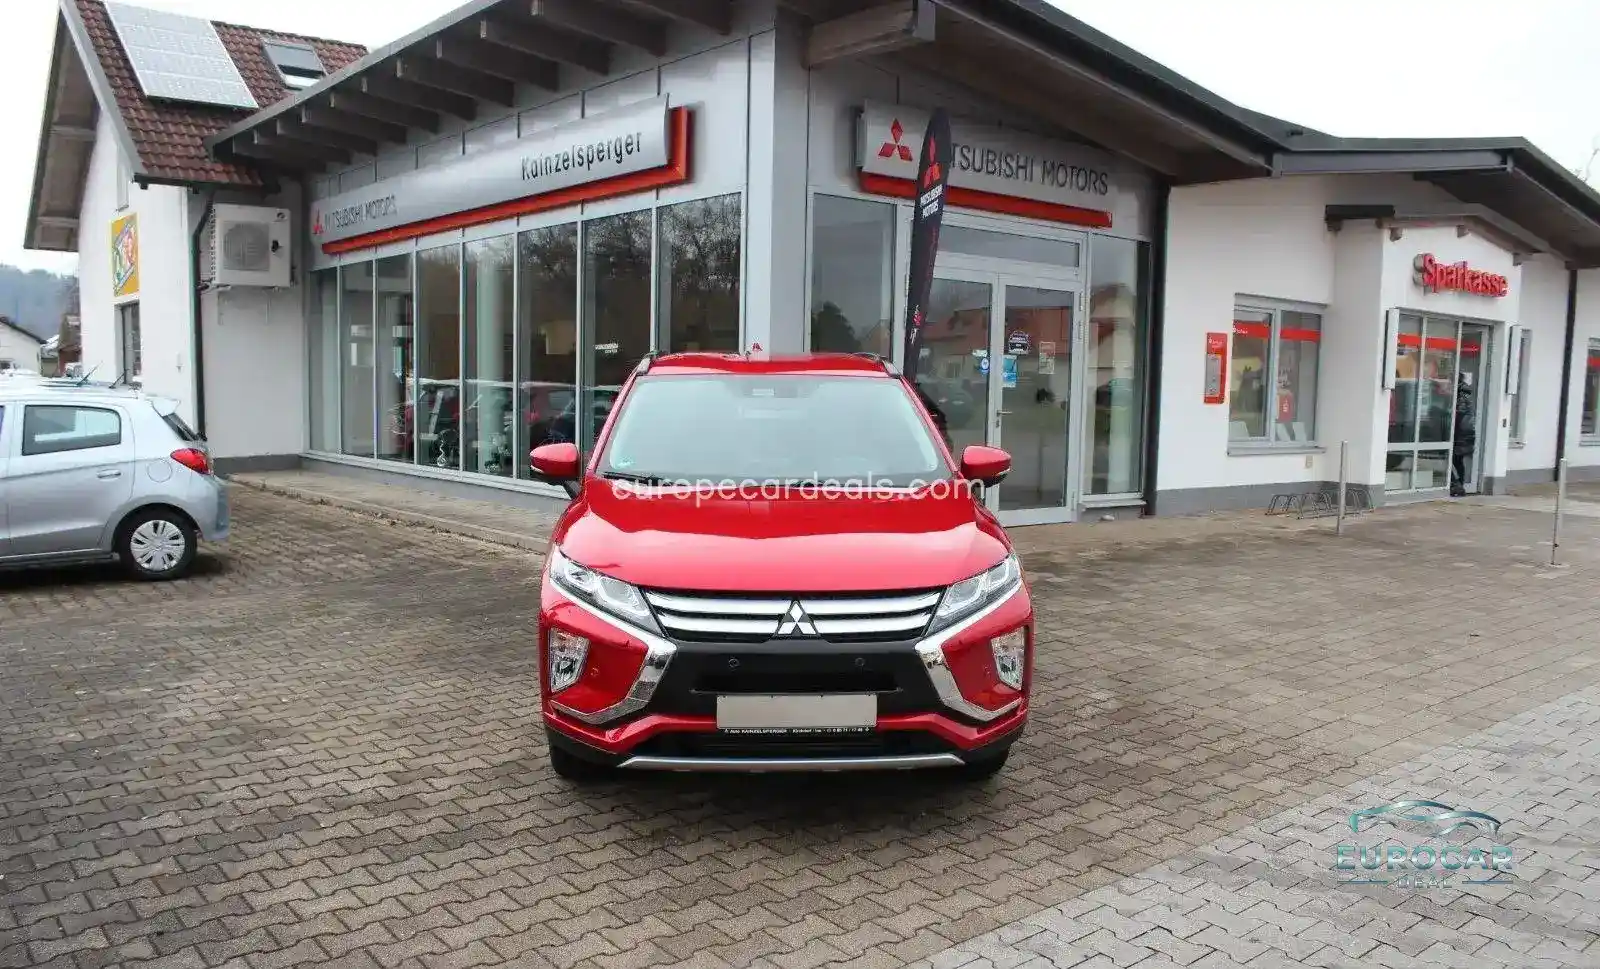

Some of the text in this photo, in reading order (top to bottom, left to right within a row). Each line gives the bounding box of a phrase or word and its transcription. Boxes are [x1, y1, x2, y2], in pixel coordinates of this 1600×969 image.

[521, 131, 643, 181] Kainzelsperger
[950, 142, 1109, 196] TSUBISHI MOTORS
[365, 194, 397, 221] MOTORS
[1422, 253, 1509, 298] Sparkasse
